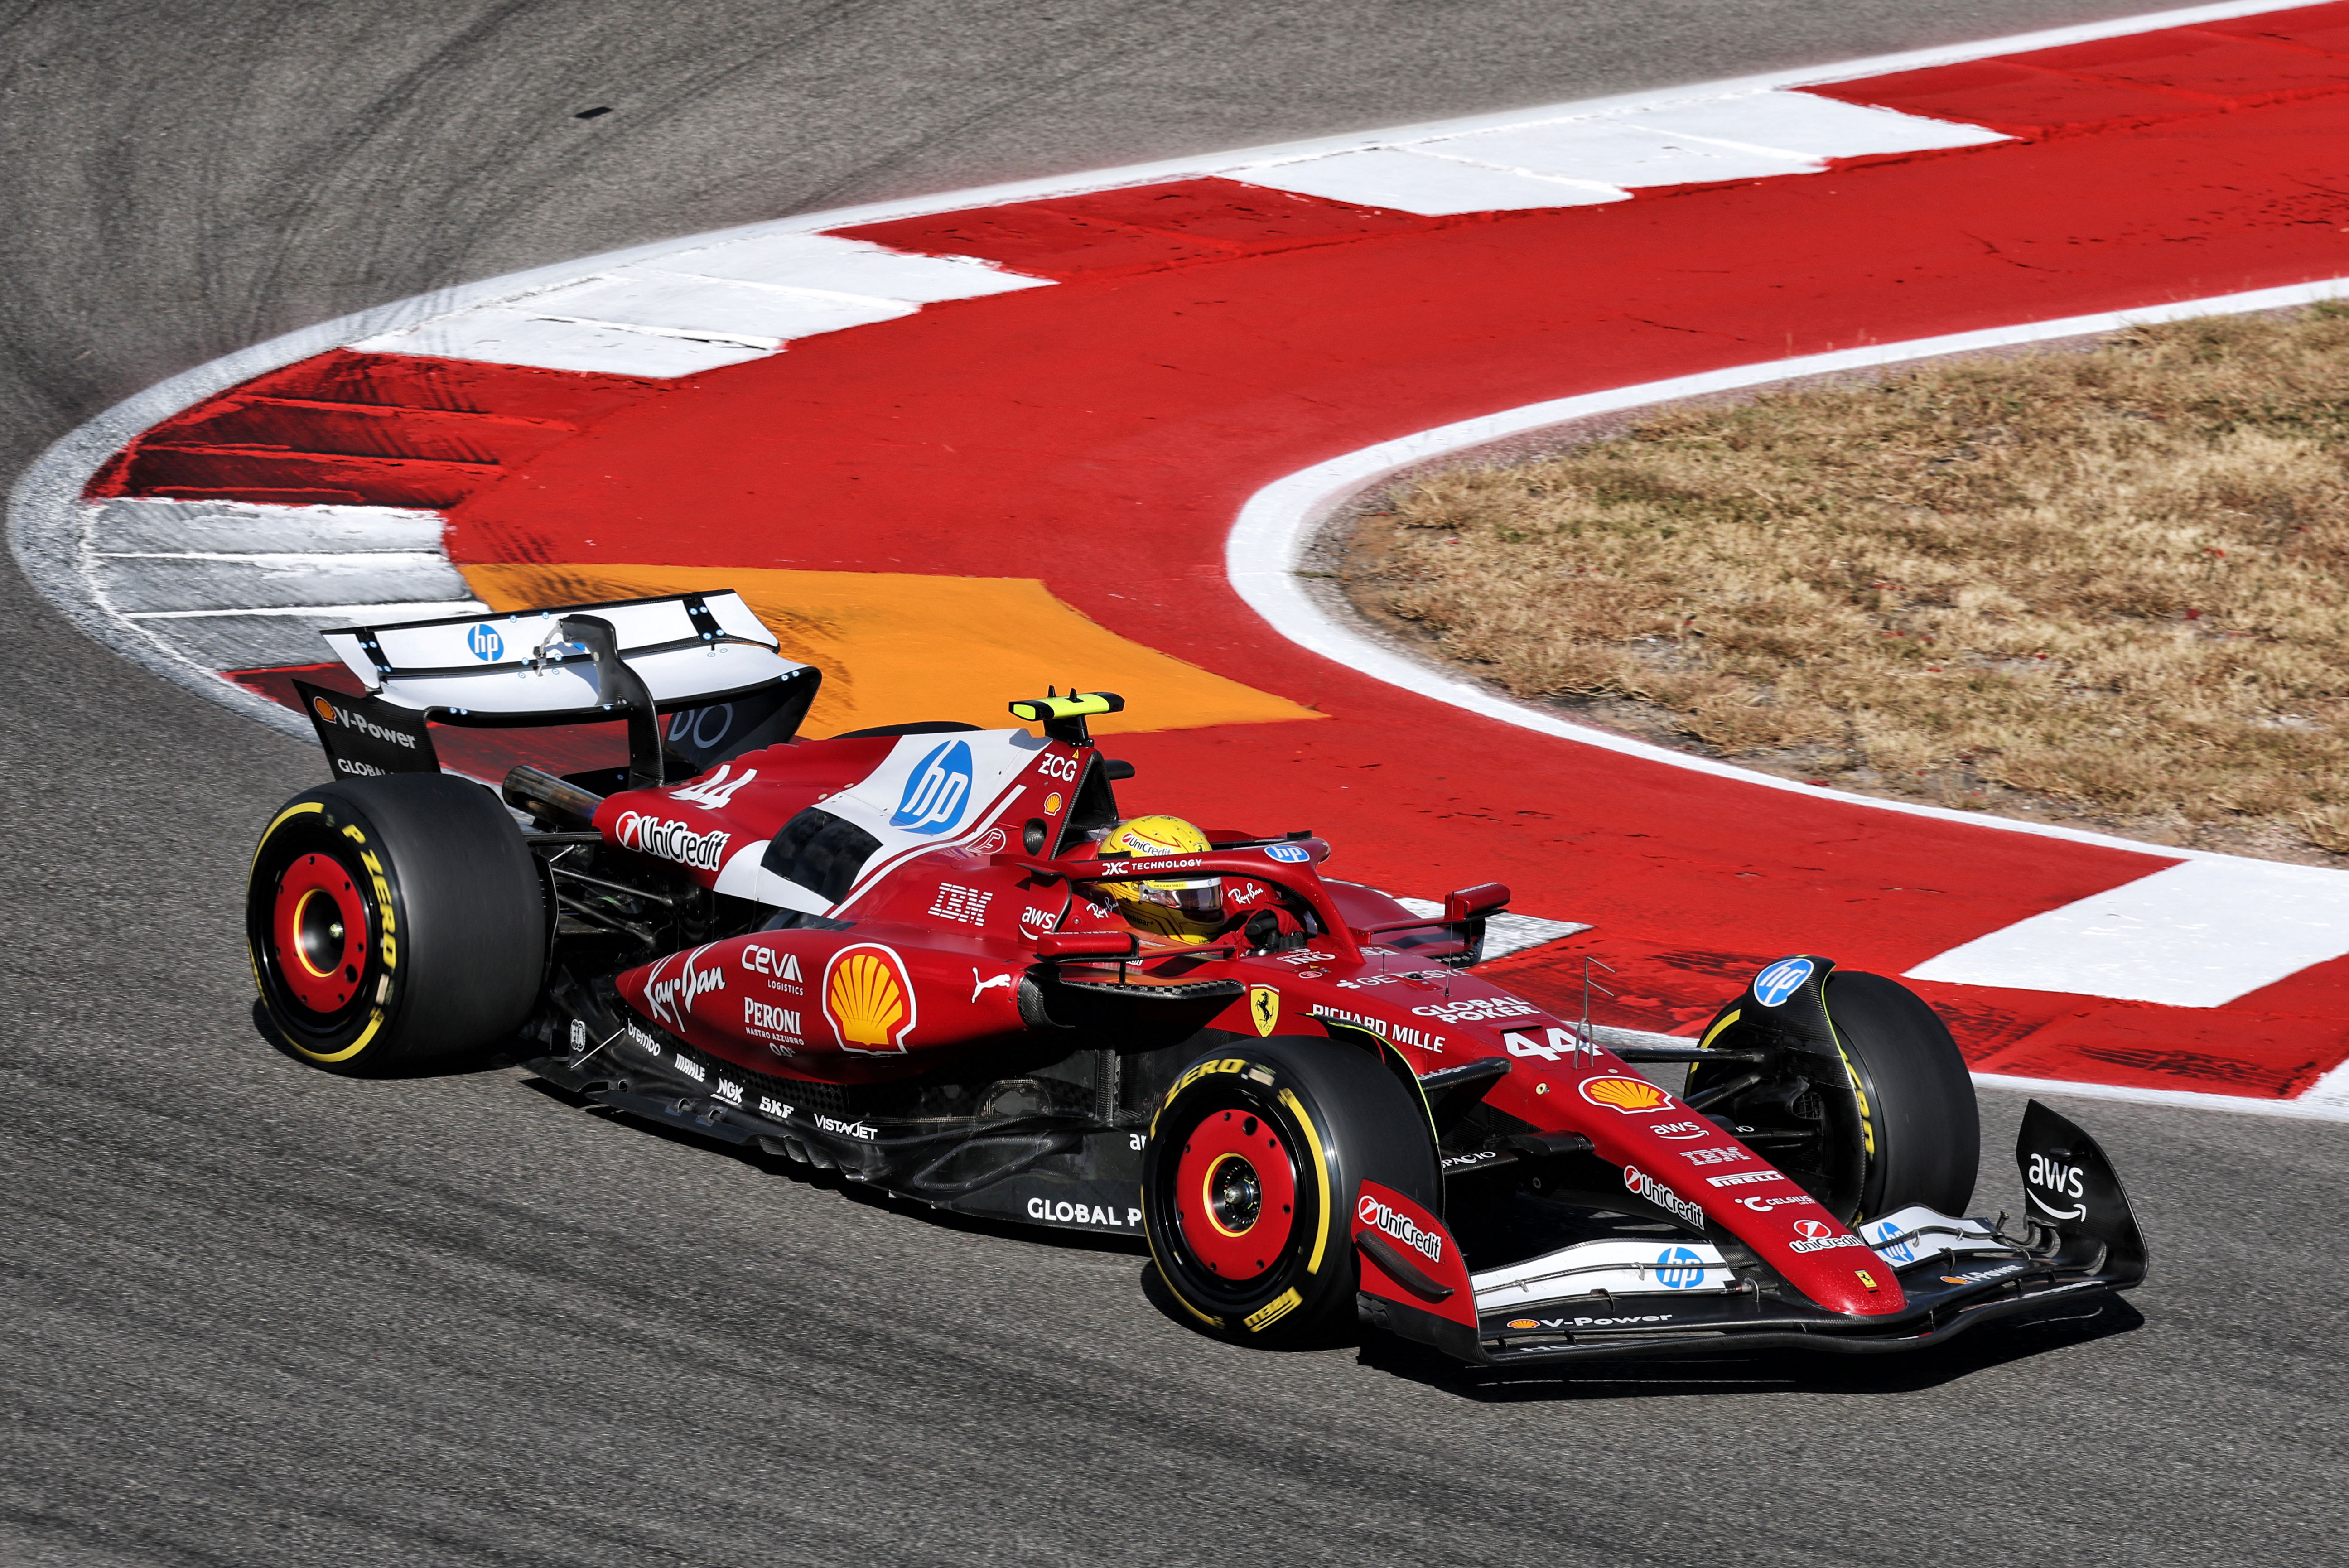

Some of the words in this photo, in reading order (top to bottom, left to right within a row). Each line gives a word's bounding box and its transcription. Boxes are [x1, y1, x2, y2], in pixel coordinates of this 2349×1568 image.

[471, 624, 502, 661] hp
[333, 706, 416, 749] V-Power
[1038, 752, 1077, 782] ZCG
[669, 764, 757, 810] 44
[890, 740, 971, 830] hp
[640, 816, 728, 869] UniCredit
[1129, 837, 1171, 856] UniCredit
[1268, 846, 1305, 862] hp
[1102, 862, 1129, 876] DXC
[1132, 859, 1202, 870] TECHNOLOGY
[342, 824, 366, 844] P
[360, 849, 397, 968] ZERO
[927, 882, 994, 927] IBM
[1022, 906, 1056, 929] aws
[767, 981, 803, 996] LOGISTICS
[1756, 958, 1810, 1006] hp
[744, 996, 801, 1035] PERONI
[1411, 996, 1532, 1017] GLOBAL
[1437, 1005, 1541, 1024] POKER
[628, 1018, 661, 1056] brembo
[746, 1027, 770, 1039] NASTRO
[772, 1033, 804, 1045] AZZURRO
[1392, 1024, 1446, 1053] MILLE
[1503, 1028, 1604, 1061] 44
[674, 1053, 705, 1082] MAHLE
[716, 1077, 743, 1103] NGK
[1164, 1058, 1246, 1110] ZERO
[759, 1096, 794, 1119] SKF
[1650, 1121, 1701, 1134] aws
[1679, 1146, 1751, 1166] IBM
[1706, 1170, 1785, 1187] PIRELLI
[2029, 1153, 2084, 1198] aws
[1027, 1197, 1121, 1226] GLOBAL
[1642, 1174, 1704, 1229] UniCredit
[1765, 1195, 1814, 1205] CELSIUS
[1378, 1204, 1441, 1262] UniCredit
[1791, 1235, 1862, 1253] UniCredit
[1879, 1222, 1912, 1261] hp
[1660, 1247, 1703, 1288] hp
[1956, 1264, 2023, 1282] V-Power
[1540, 1313, 1673, 1327] V-Power
